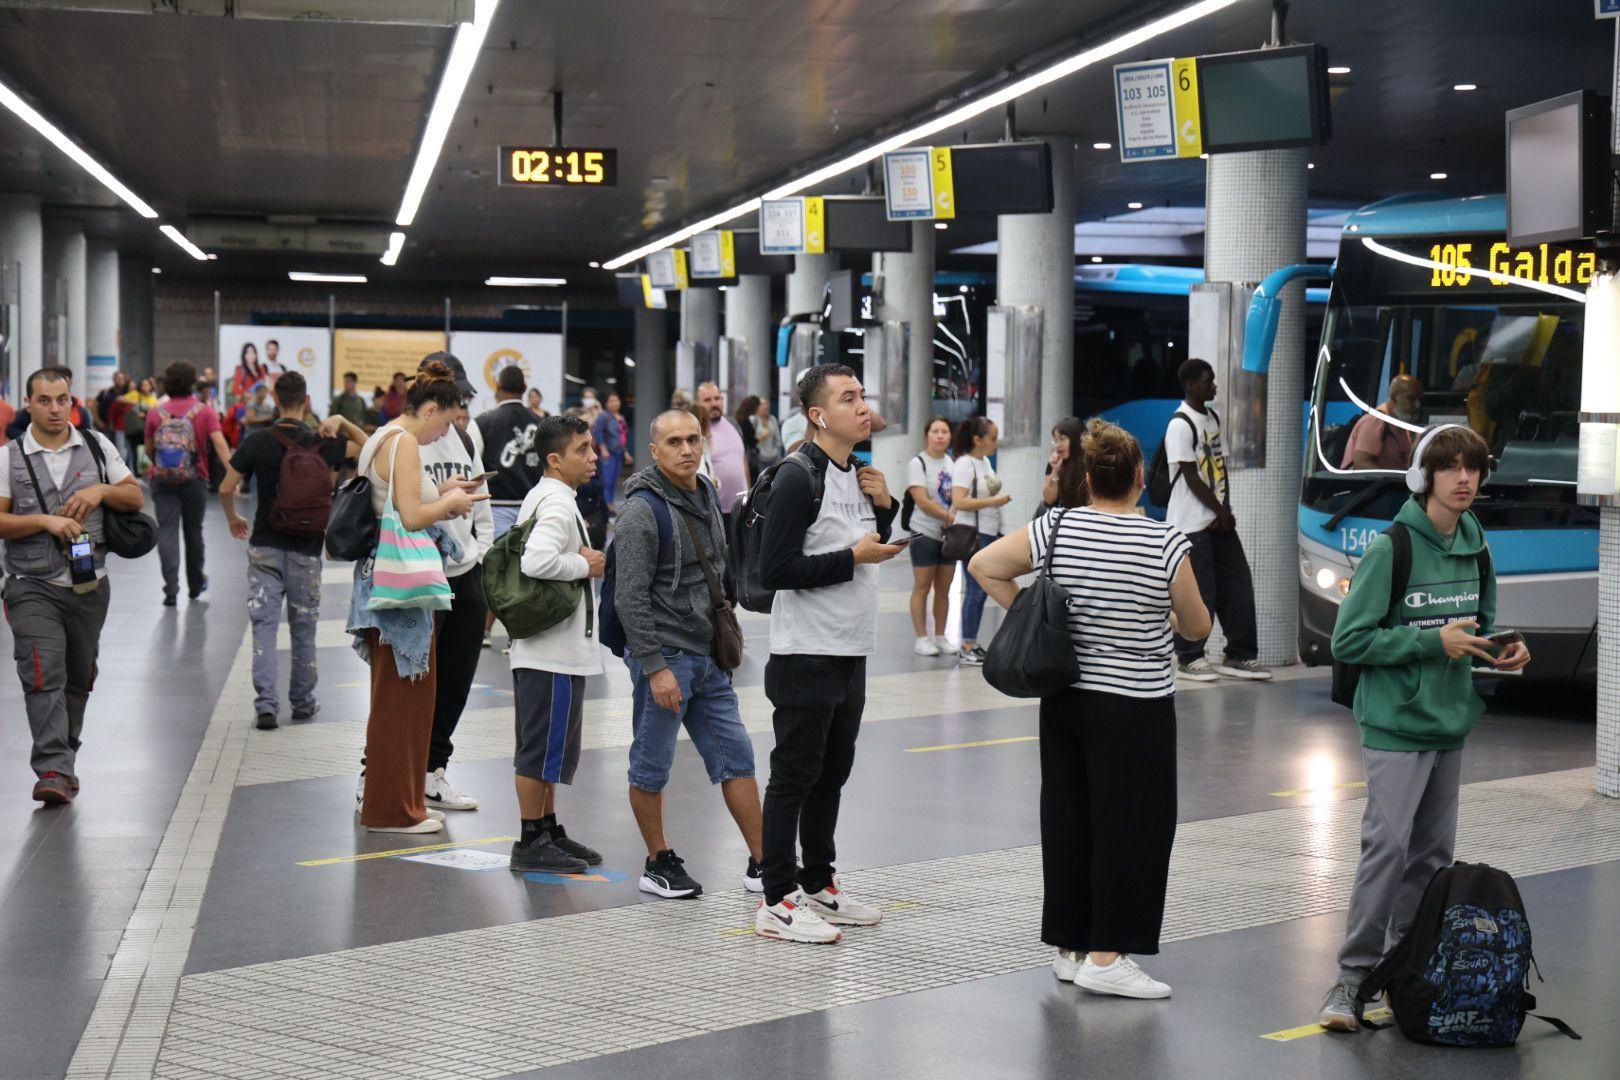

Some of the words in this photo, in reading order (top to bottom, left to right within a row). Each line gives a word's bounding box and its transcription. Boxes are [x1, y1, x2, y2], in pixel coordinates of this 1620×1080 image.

[1179, 68, 1190, 91] 6
[1123, 87, 1142, 101] 103
[1147, 85, 1166, 98] 105
[512, 151, 603, 183] 02:15
[937, 155, 946, 171] 5
[808, 202, 818, 215] 4
[1430, 244, 1472, 286] 105
[1408, 618, 1446, 627] AUTHENTIC
[1428, 1010, 1480, 1027] SURF
